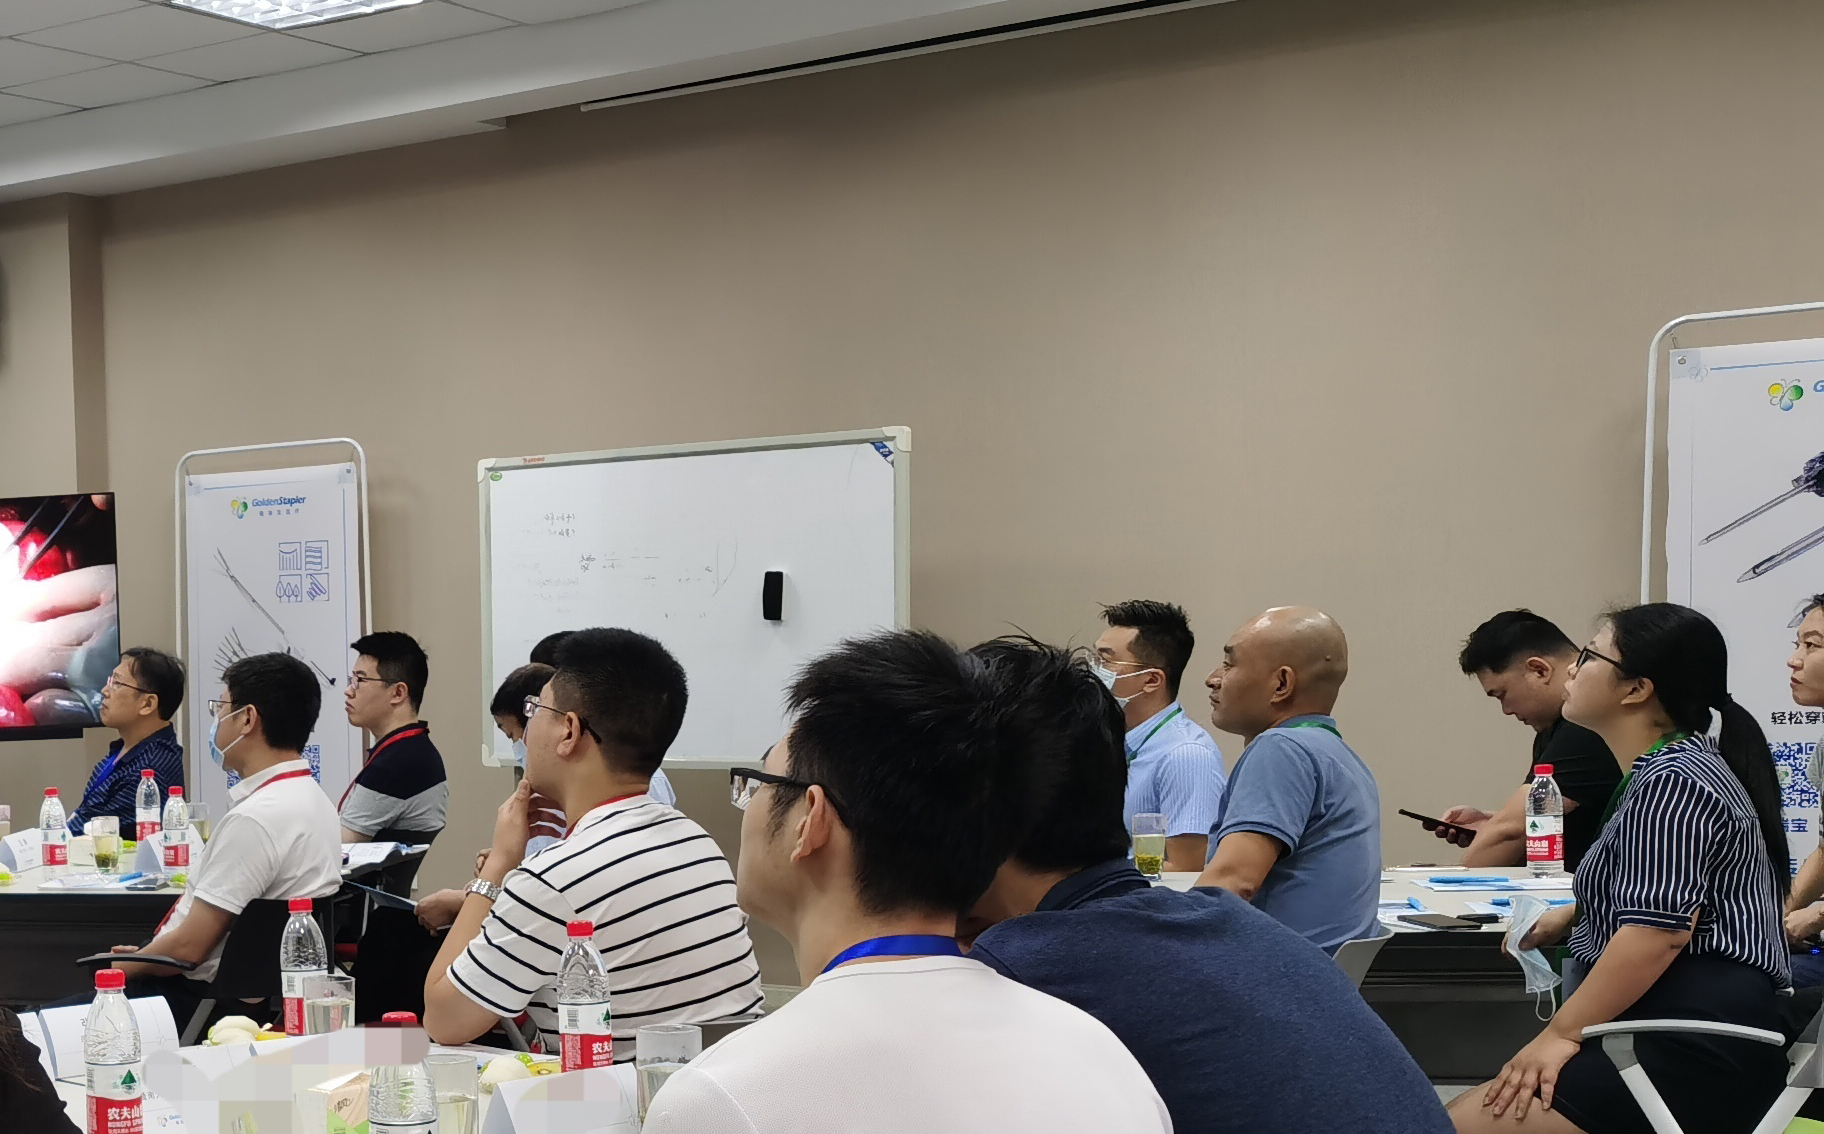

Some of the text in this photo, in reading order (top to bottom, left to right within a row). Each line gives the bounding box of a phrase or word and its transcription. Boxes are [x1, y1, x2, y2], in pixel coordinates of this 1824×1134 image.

[251, 495, 307, 508] GoldenStapler
[1771, 710, 1824, 725] 轻松穿
